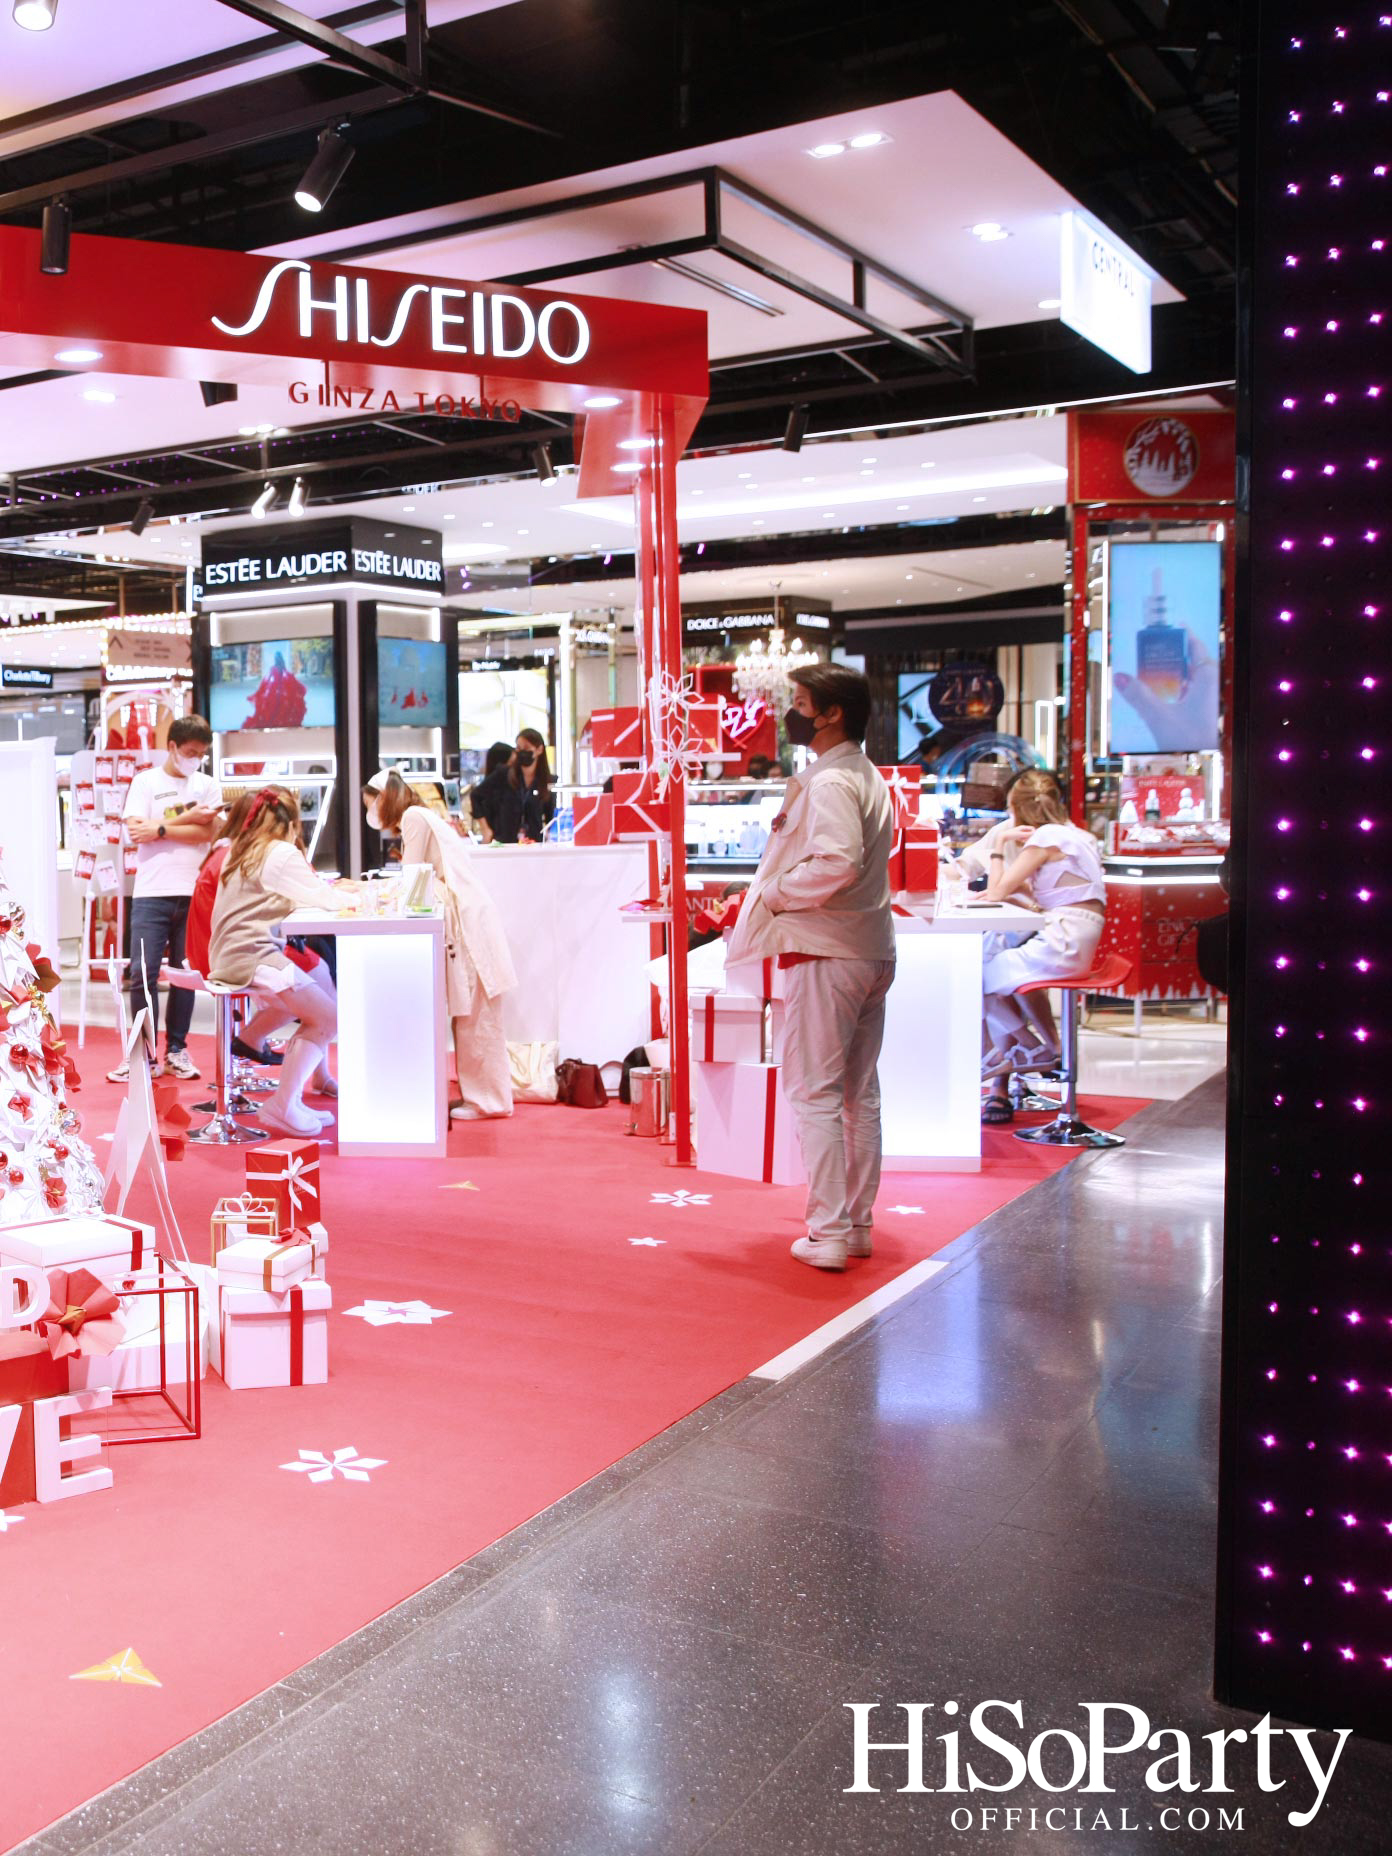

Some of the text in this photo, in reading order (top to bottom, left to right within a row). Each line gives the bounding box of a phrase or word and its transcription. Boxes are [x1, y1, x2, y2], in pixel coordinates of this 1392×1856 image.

[211, 259, 591, 365] SHISEIDO
[288, 381, 521, 422] GINZA TOKYO
[265, 550, 348, 578] LAUDER
[393, 557, 442, 582] LAUDER
